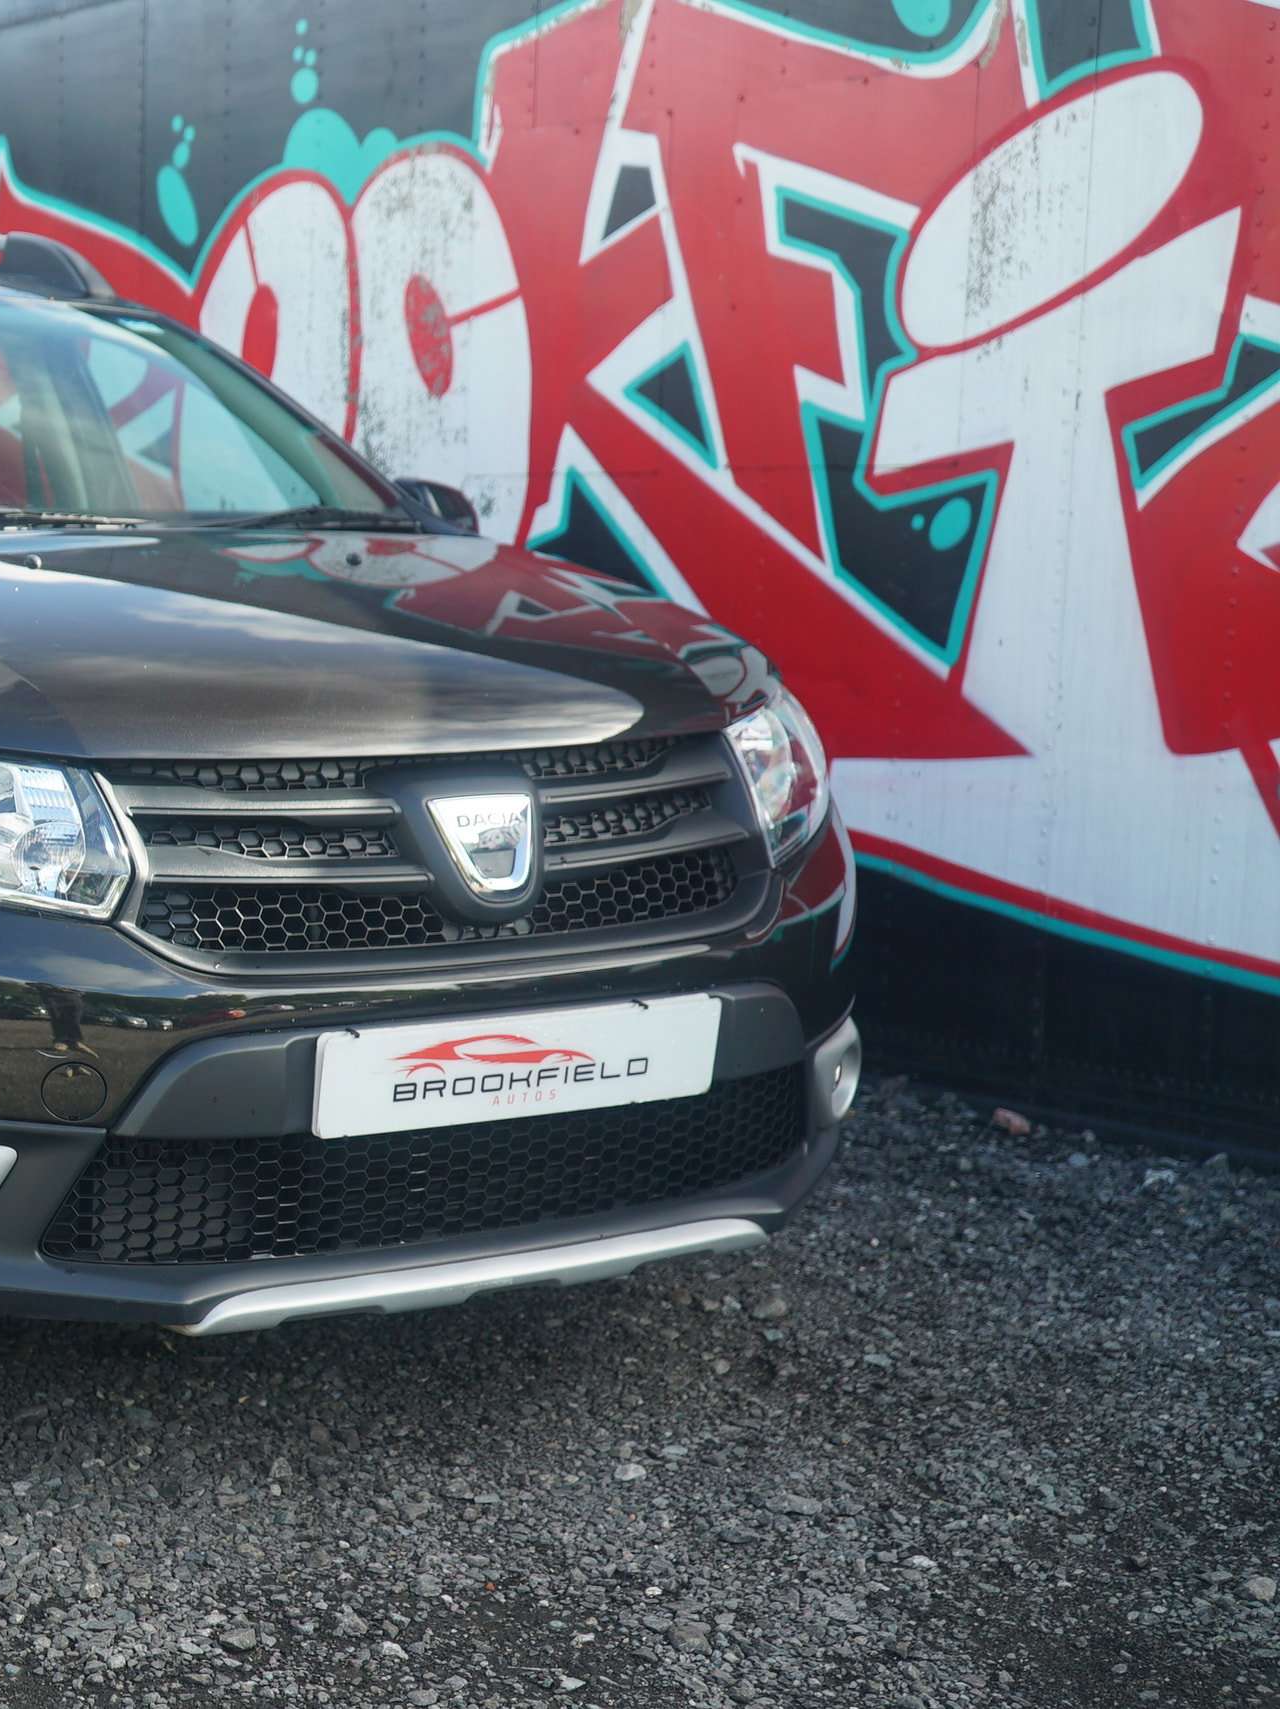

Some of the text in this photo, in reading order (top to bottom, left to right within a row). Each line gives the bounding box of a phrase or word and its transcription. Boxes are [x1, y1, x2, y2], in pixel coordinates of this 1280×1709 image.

[456, 812, 522, 828] DACIA
[392, 1056, 649, 1103] BROOKFIELD
[491, 1088, 558, 1106] AUTOS
